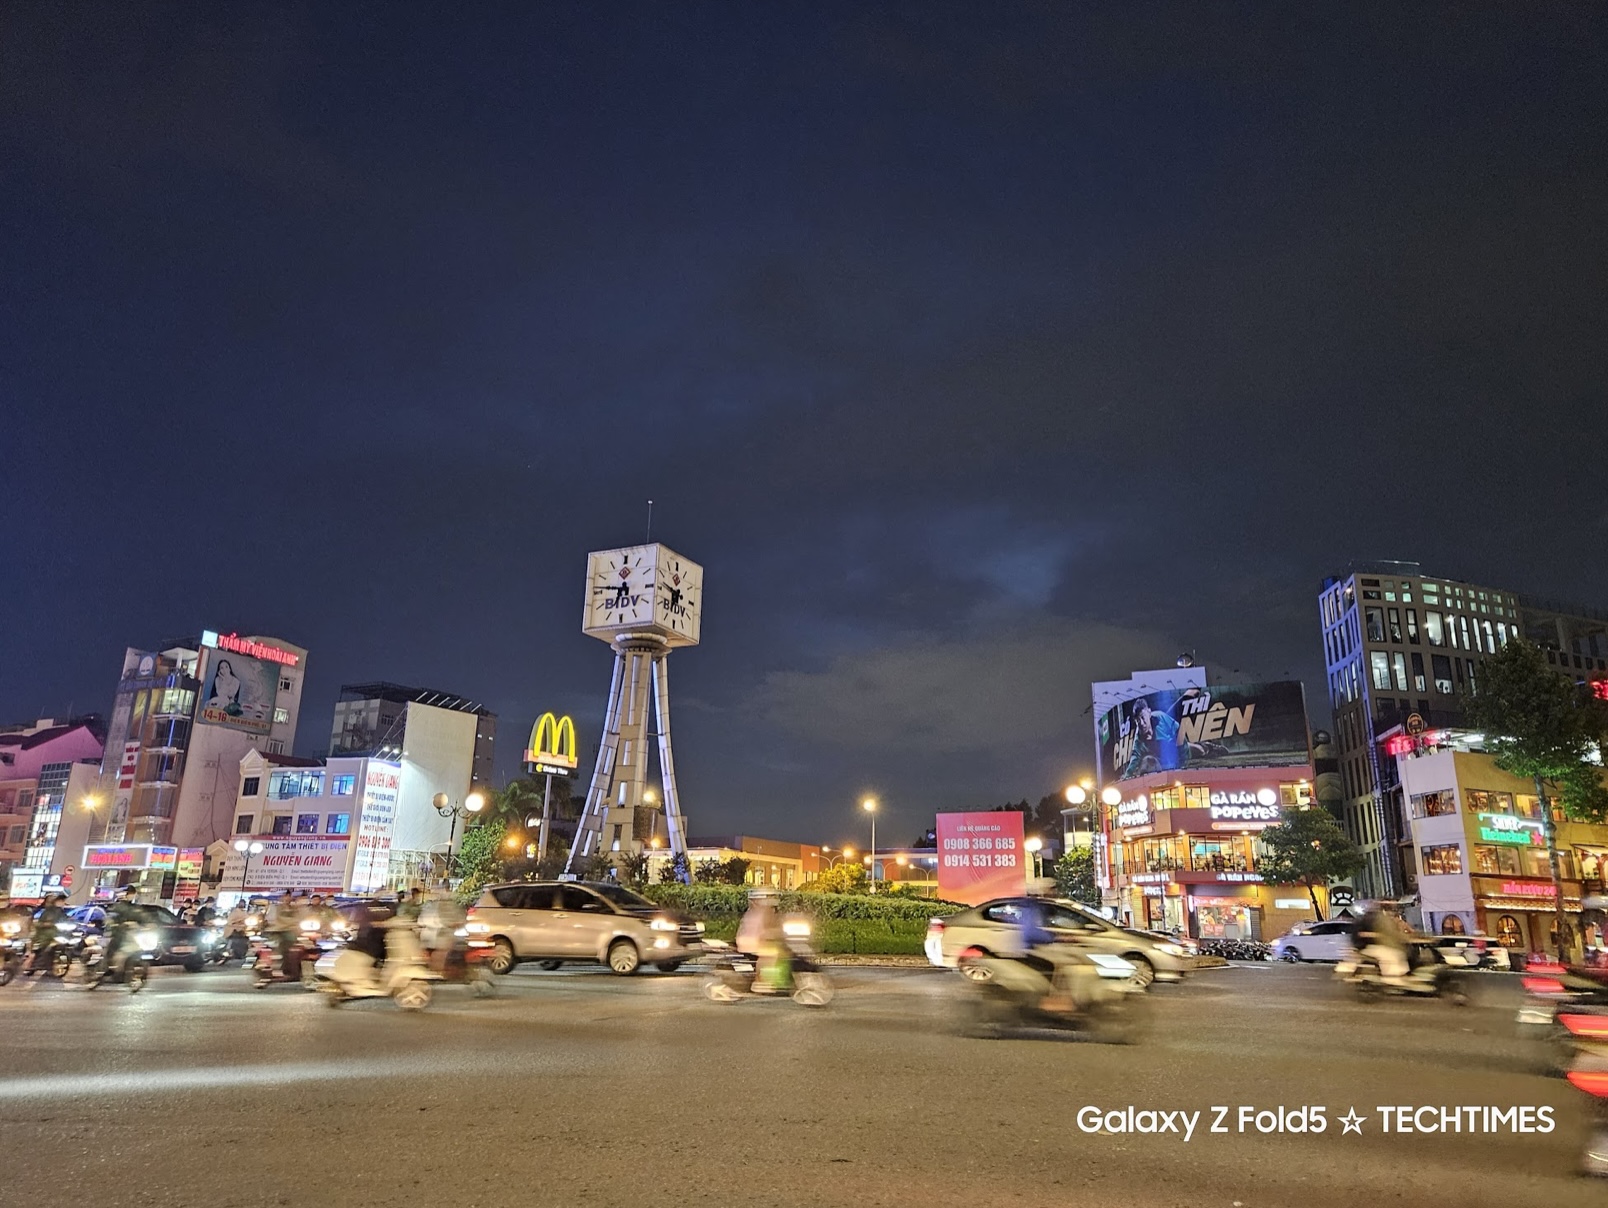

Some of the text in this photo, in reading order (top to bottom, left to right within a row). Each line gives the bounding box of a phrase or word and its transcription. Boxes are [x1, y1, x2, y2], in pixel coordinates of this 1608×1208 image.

[605, 594, 641, 610] BIDV
[663, 598, 686, 618] BIDV
[1181, 691, 1211, 716] THÌ
[1119, 715, 1131, 738] CÓ
[1176, 701, 1256, 746] NÊN
[1211, 791, 1256, 805] GÀ RÁN
[944, 837, 1016, 850] 0908 366 685
[1480, 827, 1531, 844] Heineken
[281, 840, 297, 850] TÂM
[263, 852, 332, 866] NGUYỄN GIANG
[944, 854, 1016, 867] 0914 531 383
